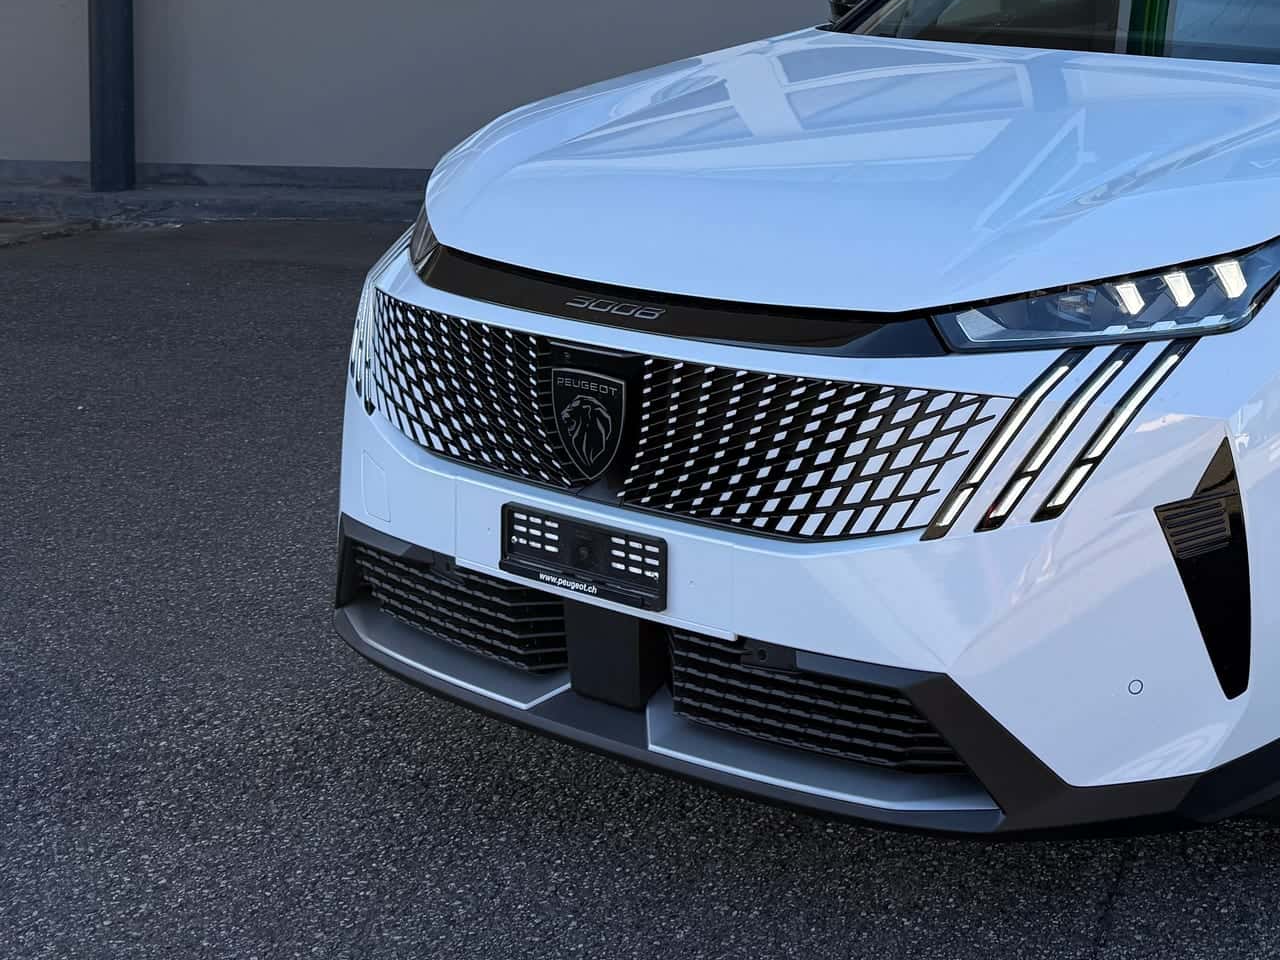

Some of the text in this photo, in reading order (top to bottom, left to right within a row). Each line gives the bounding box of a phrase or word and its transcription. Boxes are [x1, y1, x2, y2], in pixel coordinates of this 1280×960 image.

[565, 295, 666, 320] 3008
[556, 376, 618, 397] PEUGEOT
[538, 571, 598, 595] www.peugeot.ch
